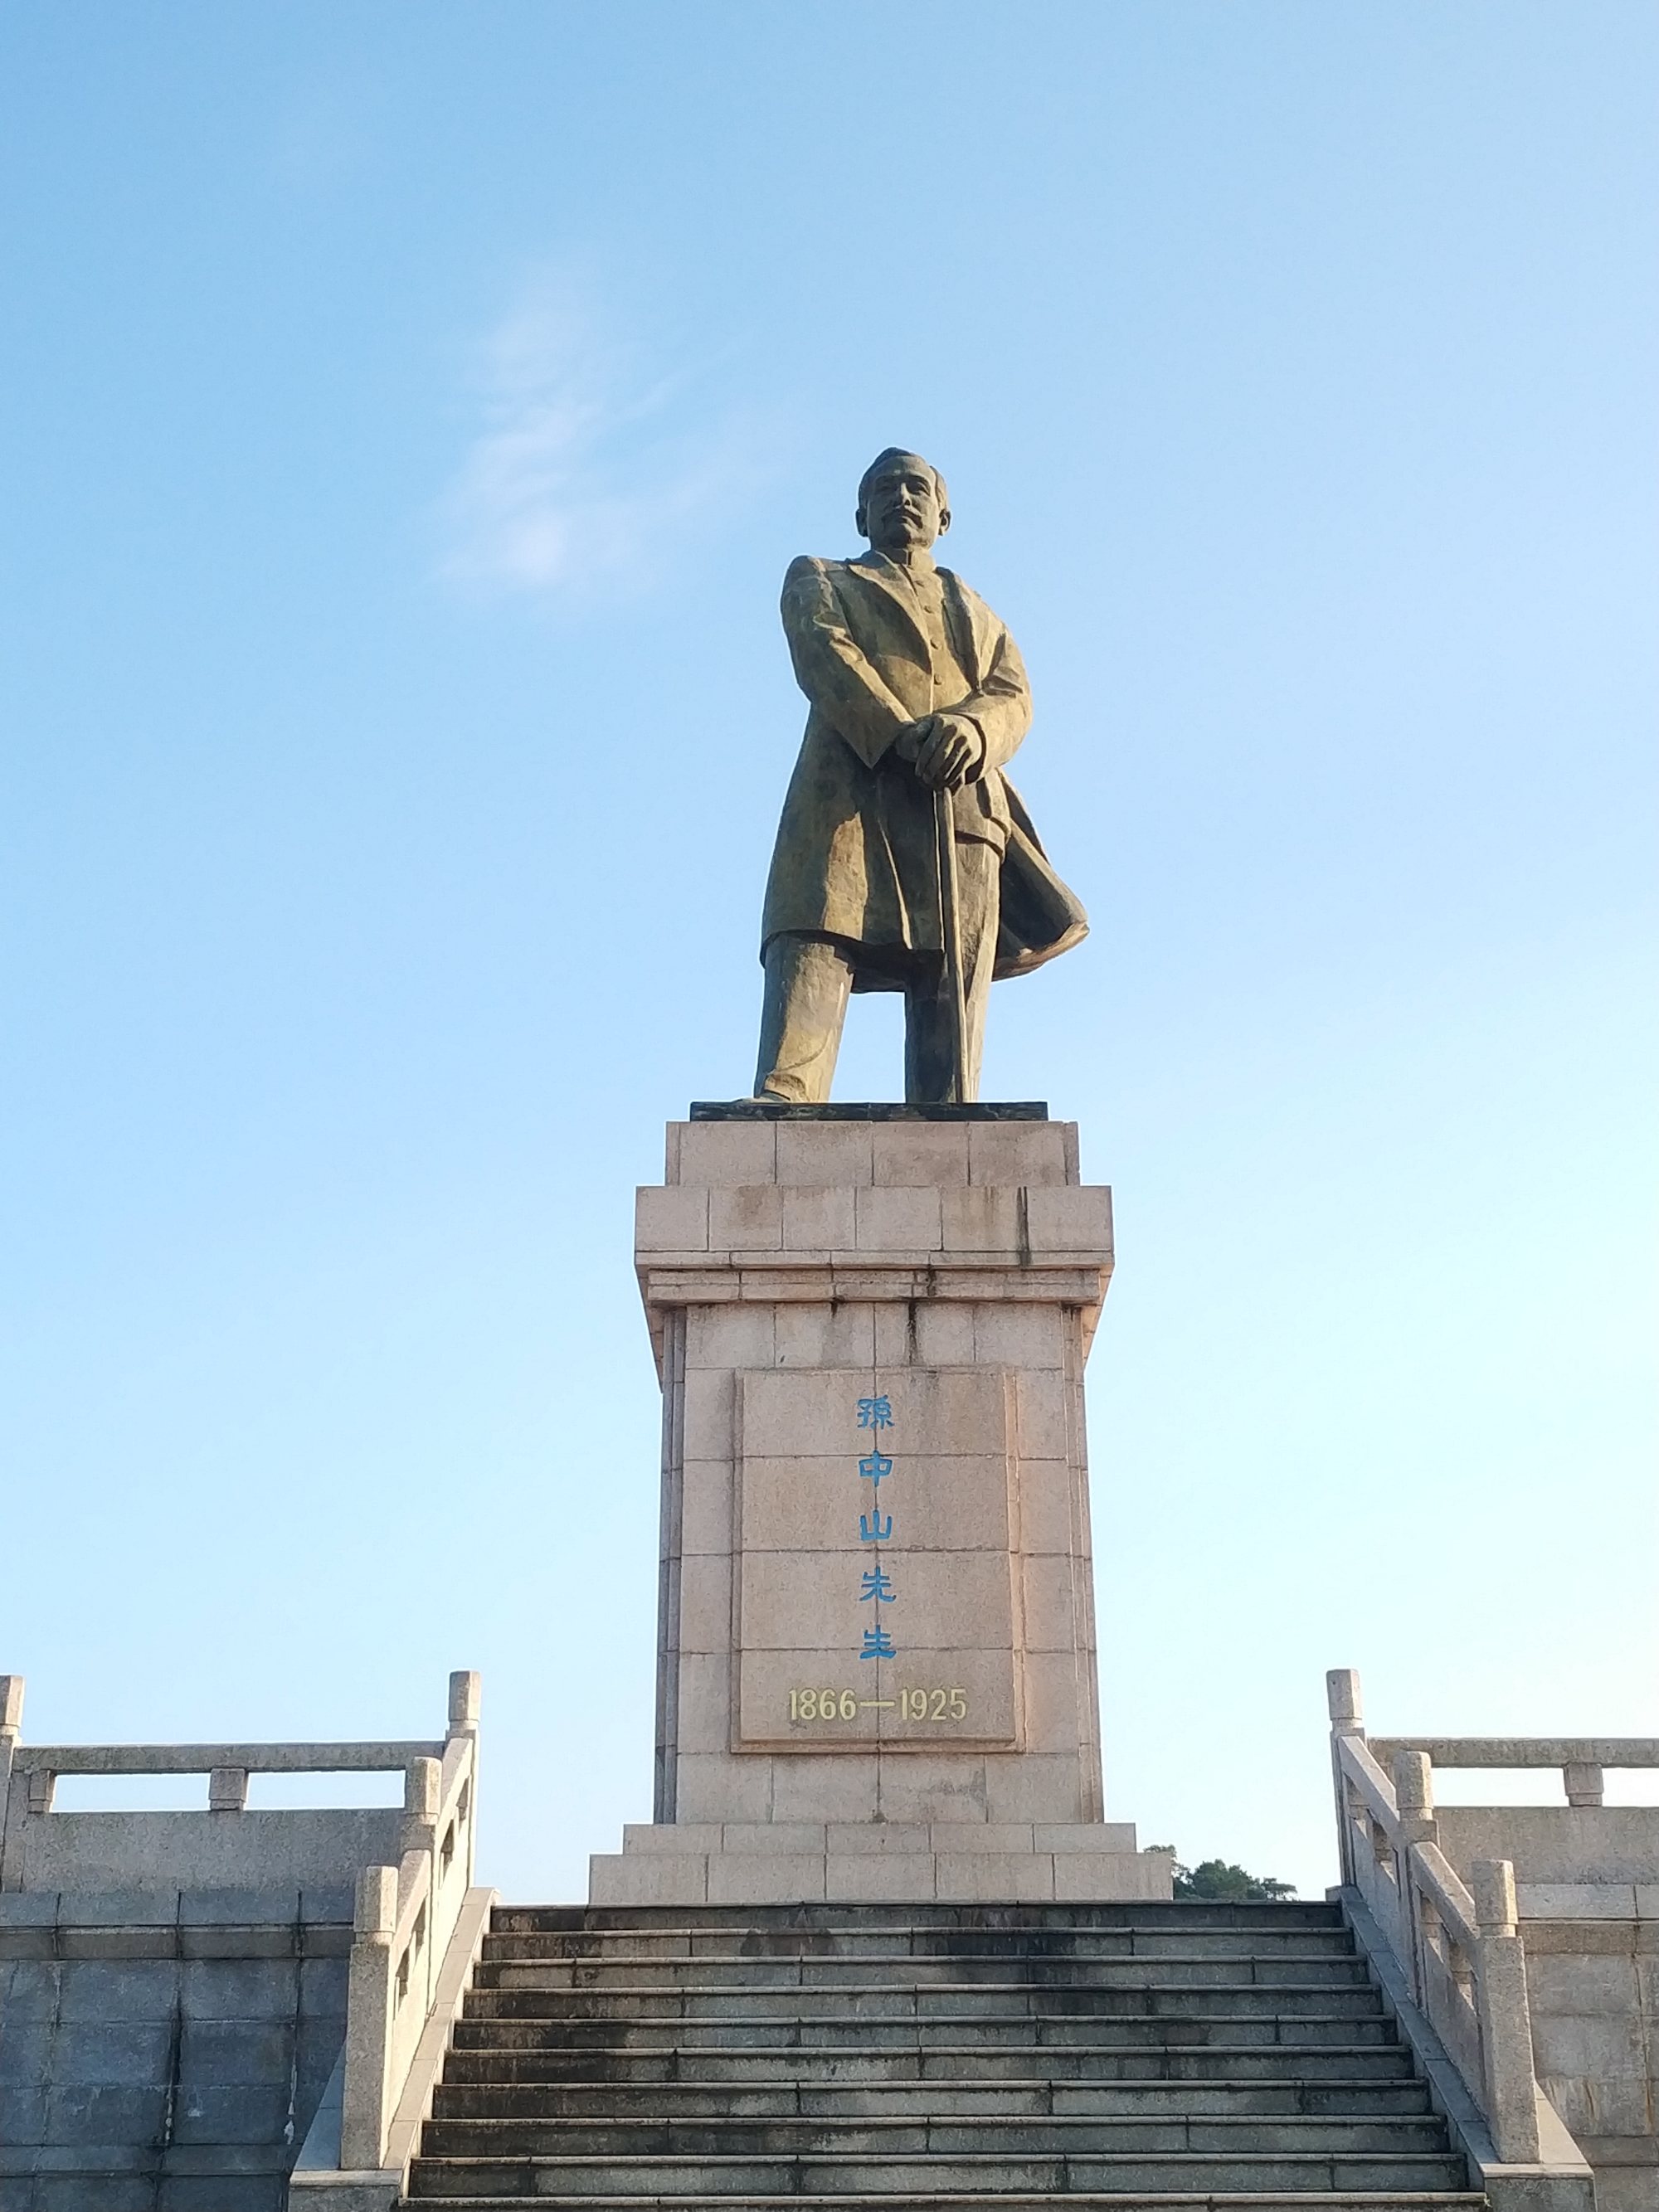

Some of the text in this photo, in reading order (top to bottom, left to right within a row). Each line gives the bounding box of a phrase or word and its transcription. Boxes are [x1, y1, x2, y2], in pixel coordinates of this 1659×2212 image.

[857, 1394, 897, 1660] 孫中山先生
